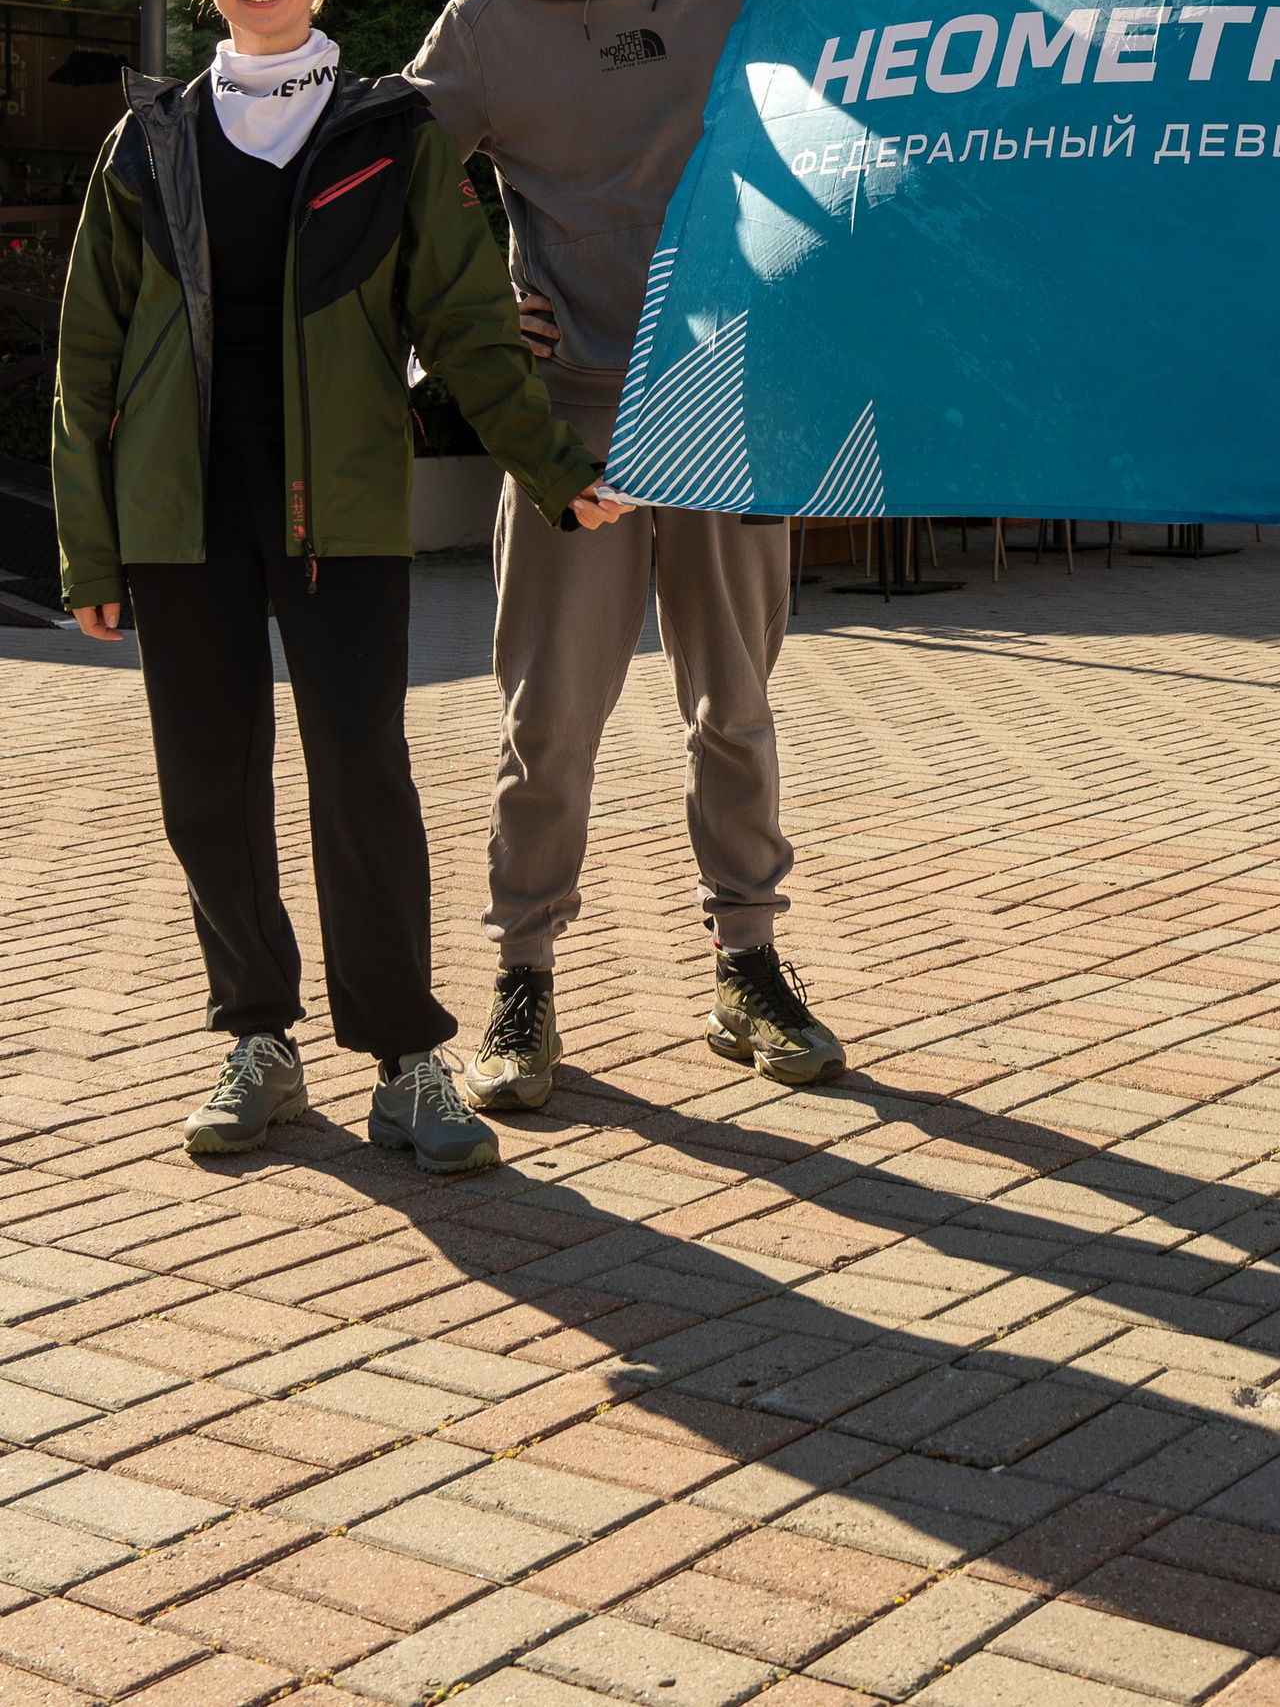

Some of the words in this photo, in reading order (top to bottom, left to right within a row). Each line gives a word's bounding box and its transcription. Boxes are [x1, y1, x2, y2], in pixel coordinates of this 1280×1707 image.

[616, 30, 641, 45] THE
[600, 39, 643, 59] NORTH
[613, 50, 644, 66] FACE
[791, 114, 1137, 178] ФЕДЕРАЛЬНЫЙ
